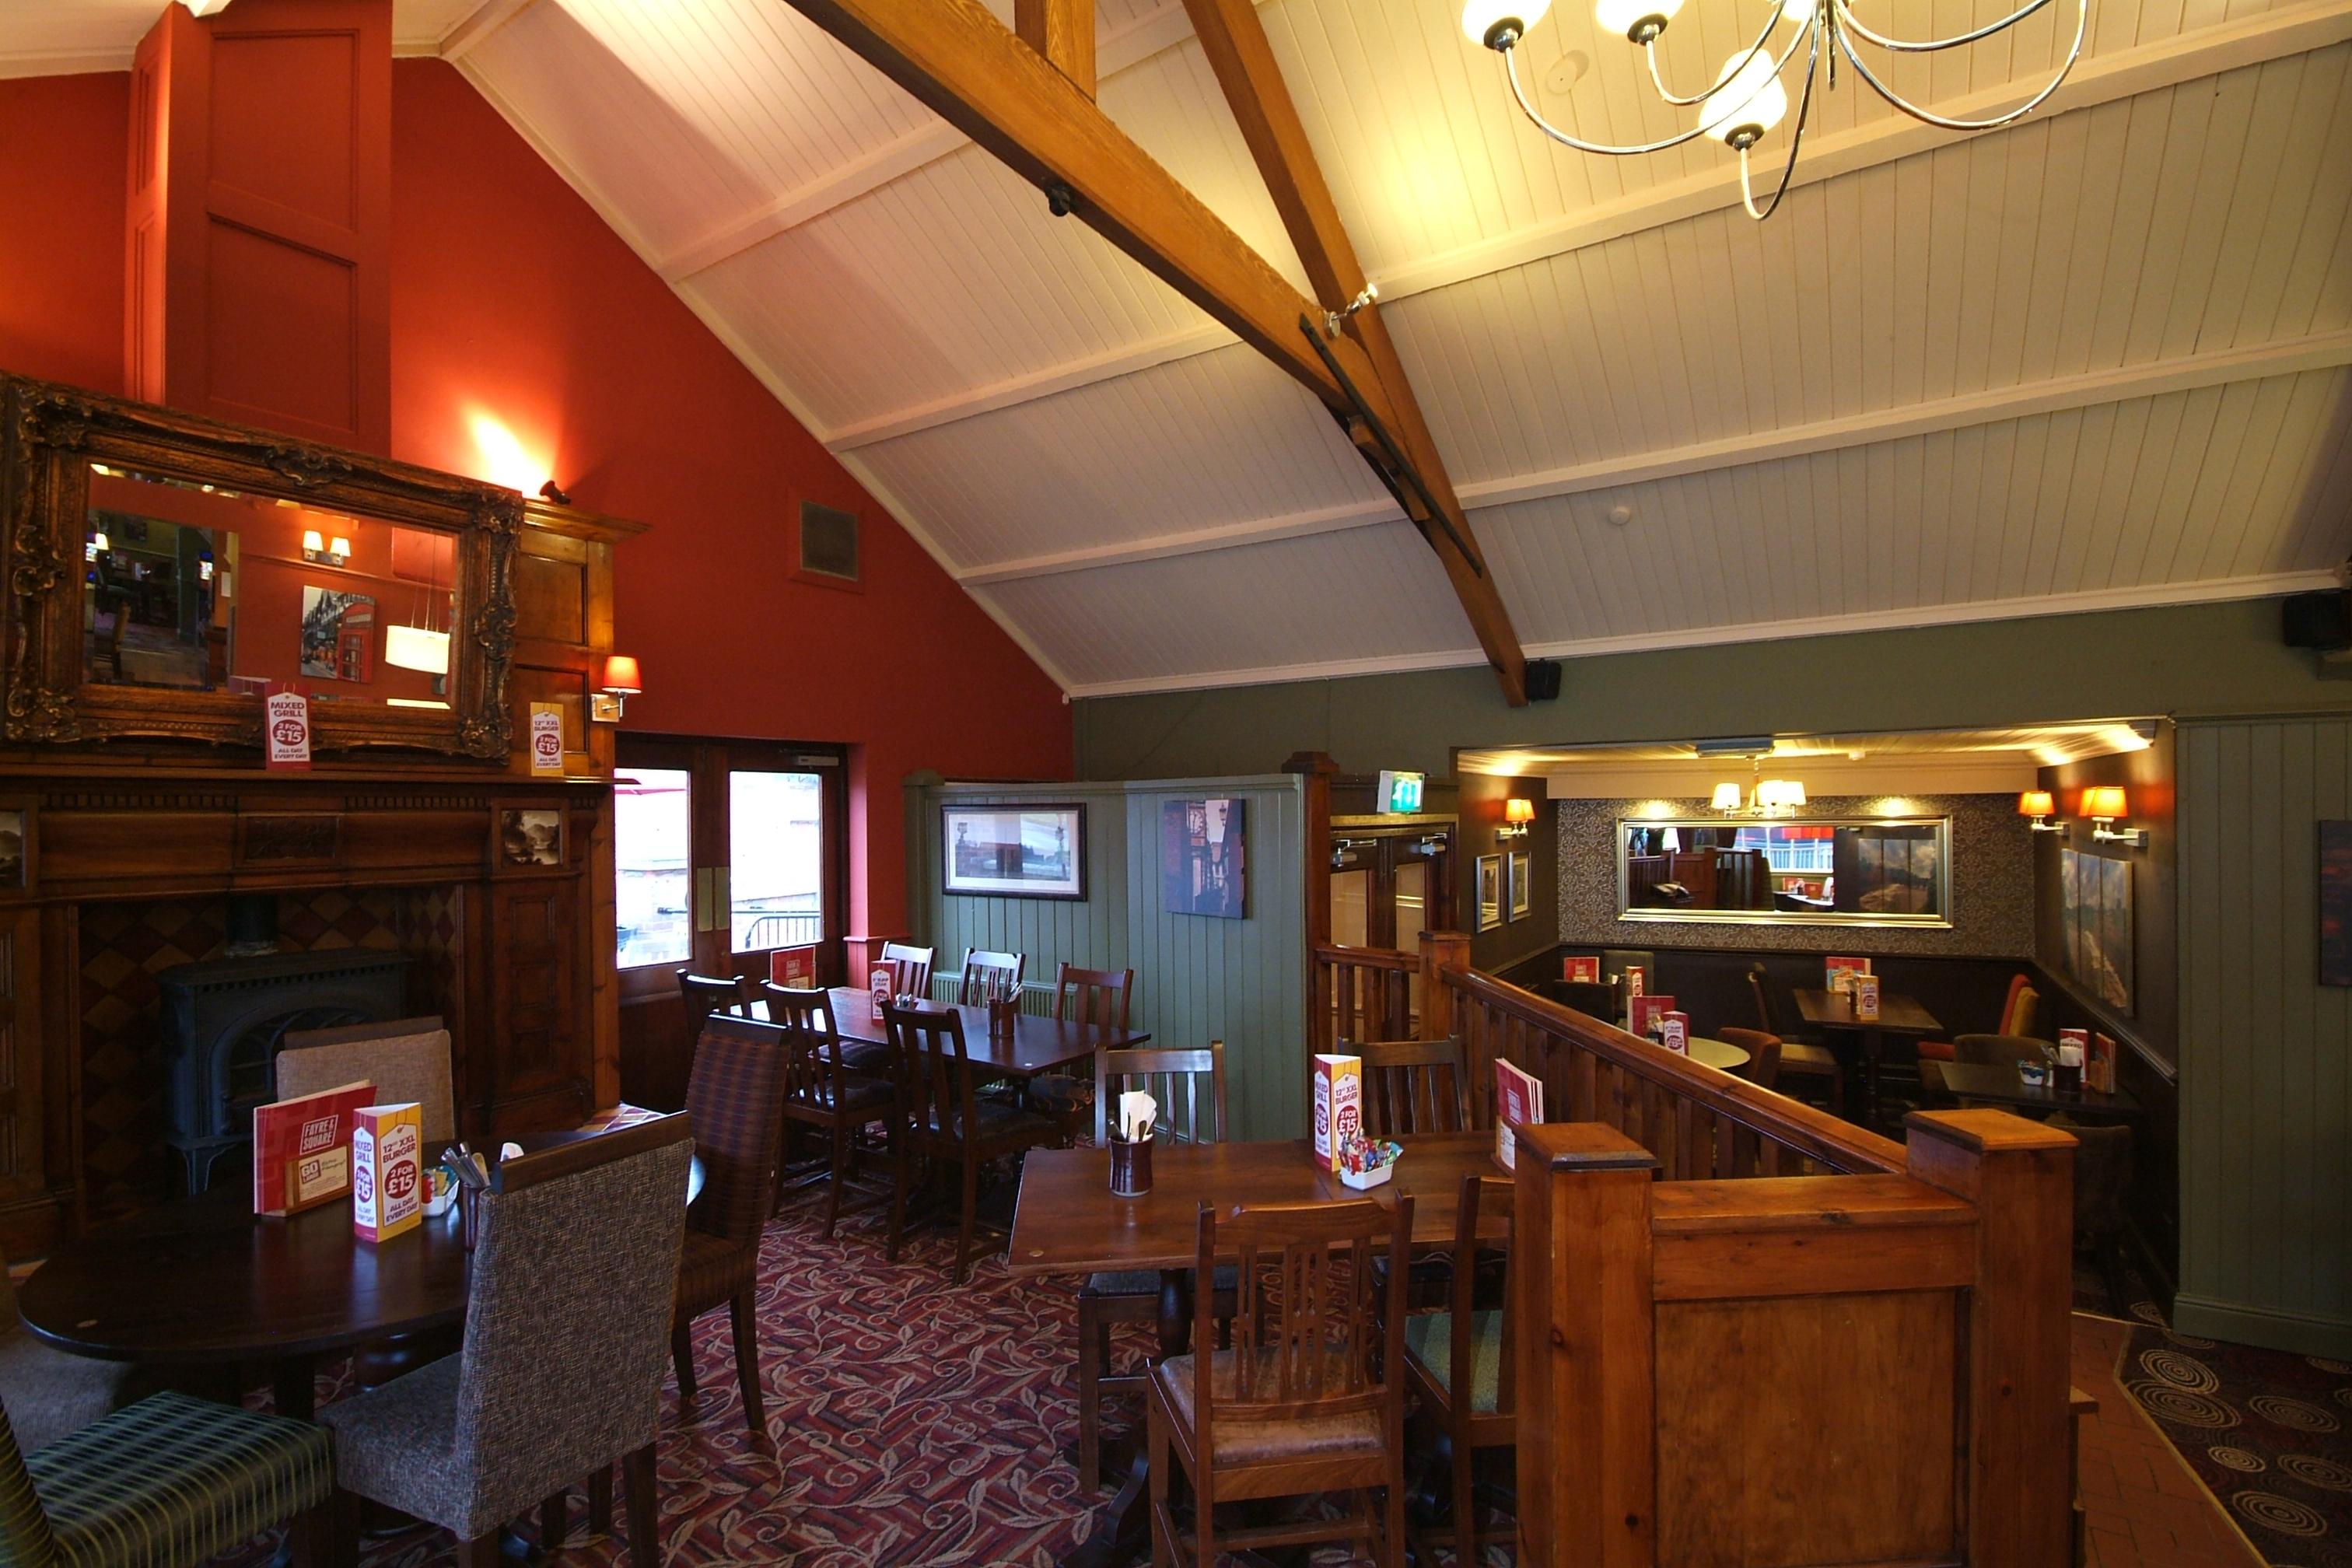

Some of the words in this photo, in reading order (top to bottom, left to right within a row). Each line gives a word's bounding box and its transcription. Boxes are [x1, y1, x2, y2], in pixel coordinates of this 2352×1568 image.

[276, 730, 303, 743] £15
[538, 743, 558, 753] £15
[1335, 1091, 1357, 1104] BURGER
[305, 1120, 329, 1137] FAYRE
[1339, 1119, 1356, 1132] £15
[303, 1132, 332, 1150] SQUARE
[399, 1135, 415, 1148] XXL
[383, 1143, 416, 1163] BURGER
[301, 1162, 319, 1177] GO
[390, 1169, 397, 1178] 2
[397, 1164, 414, 1177] FOR
[356, 1179, 371, 1199] £15
[388, 1174, 415, 1195] £15
[386, 1208, 406, 1222] EVERY
[407, 1202, 418, 1213] DAY
[390, 1202, 403, 1212] ALL
[403, 1197, 414, 1206] DAY
